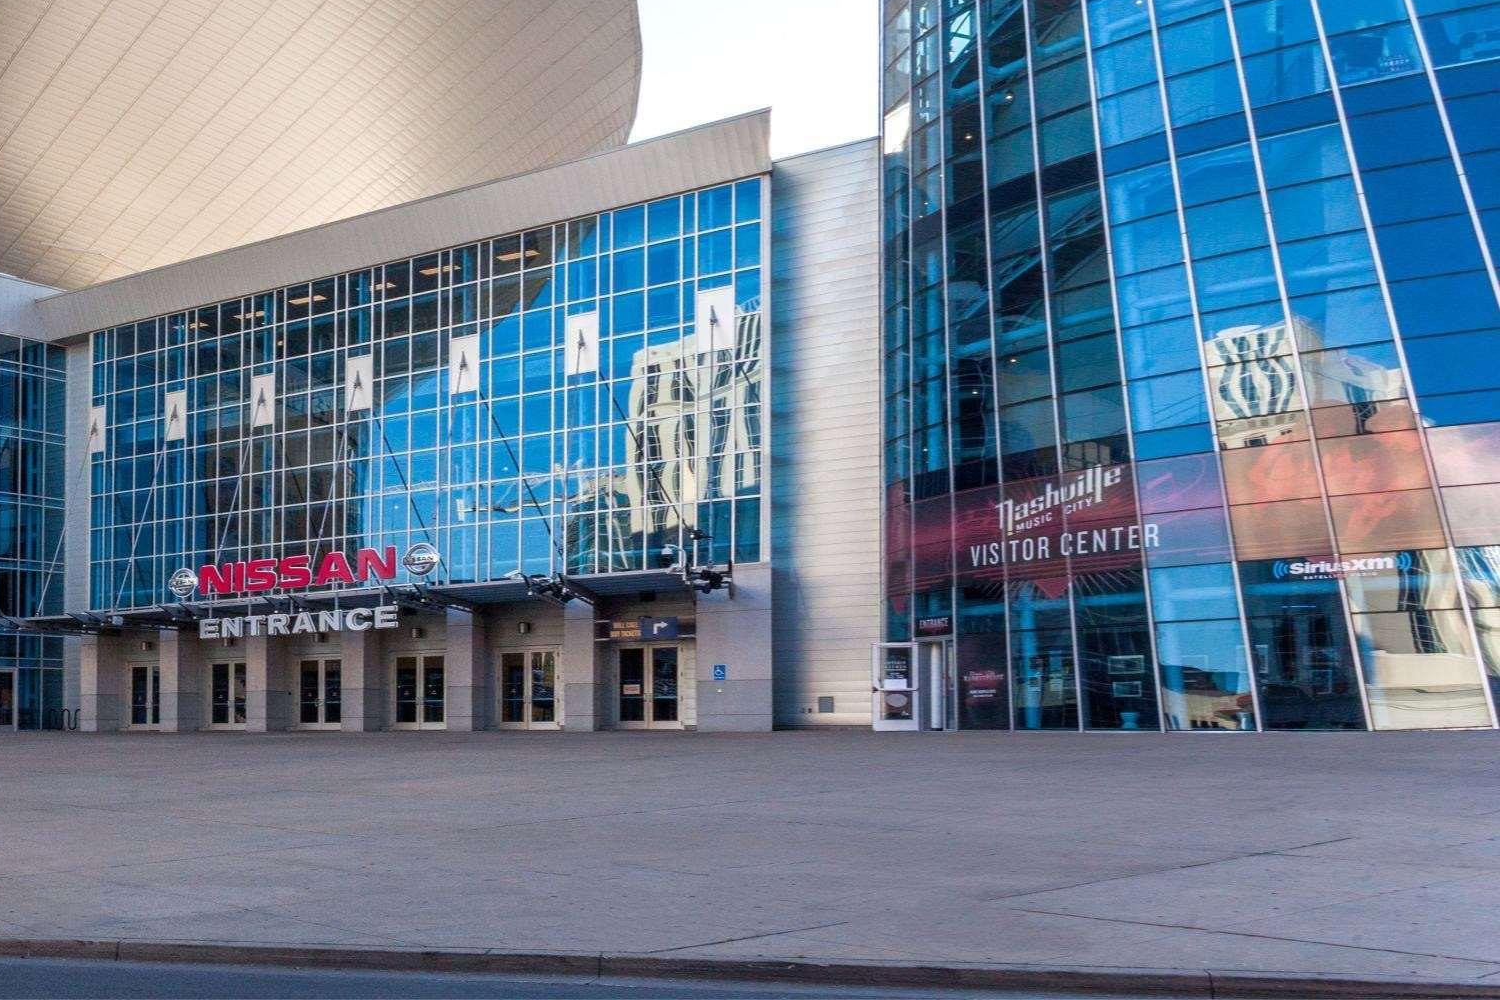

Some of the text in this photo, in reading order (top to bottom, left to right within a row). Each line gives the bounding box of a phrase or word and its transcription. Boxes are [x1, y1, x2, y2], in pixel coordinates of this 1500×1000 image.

[996, 464, 1122, 535] Nashville
[1016, 496, 1093, 533] MUSIC CITY
[970, 523, 1160, 567] VISITOR CENTER
[197, 546, 397, 595] NISSAN
[200, 605, 399, 639] ENTRANCE
